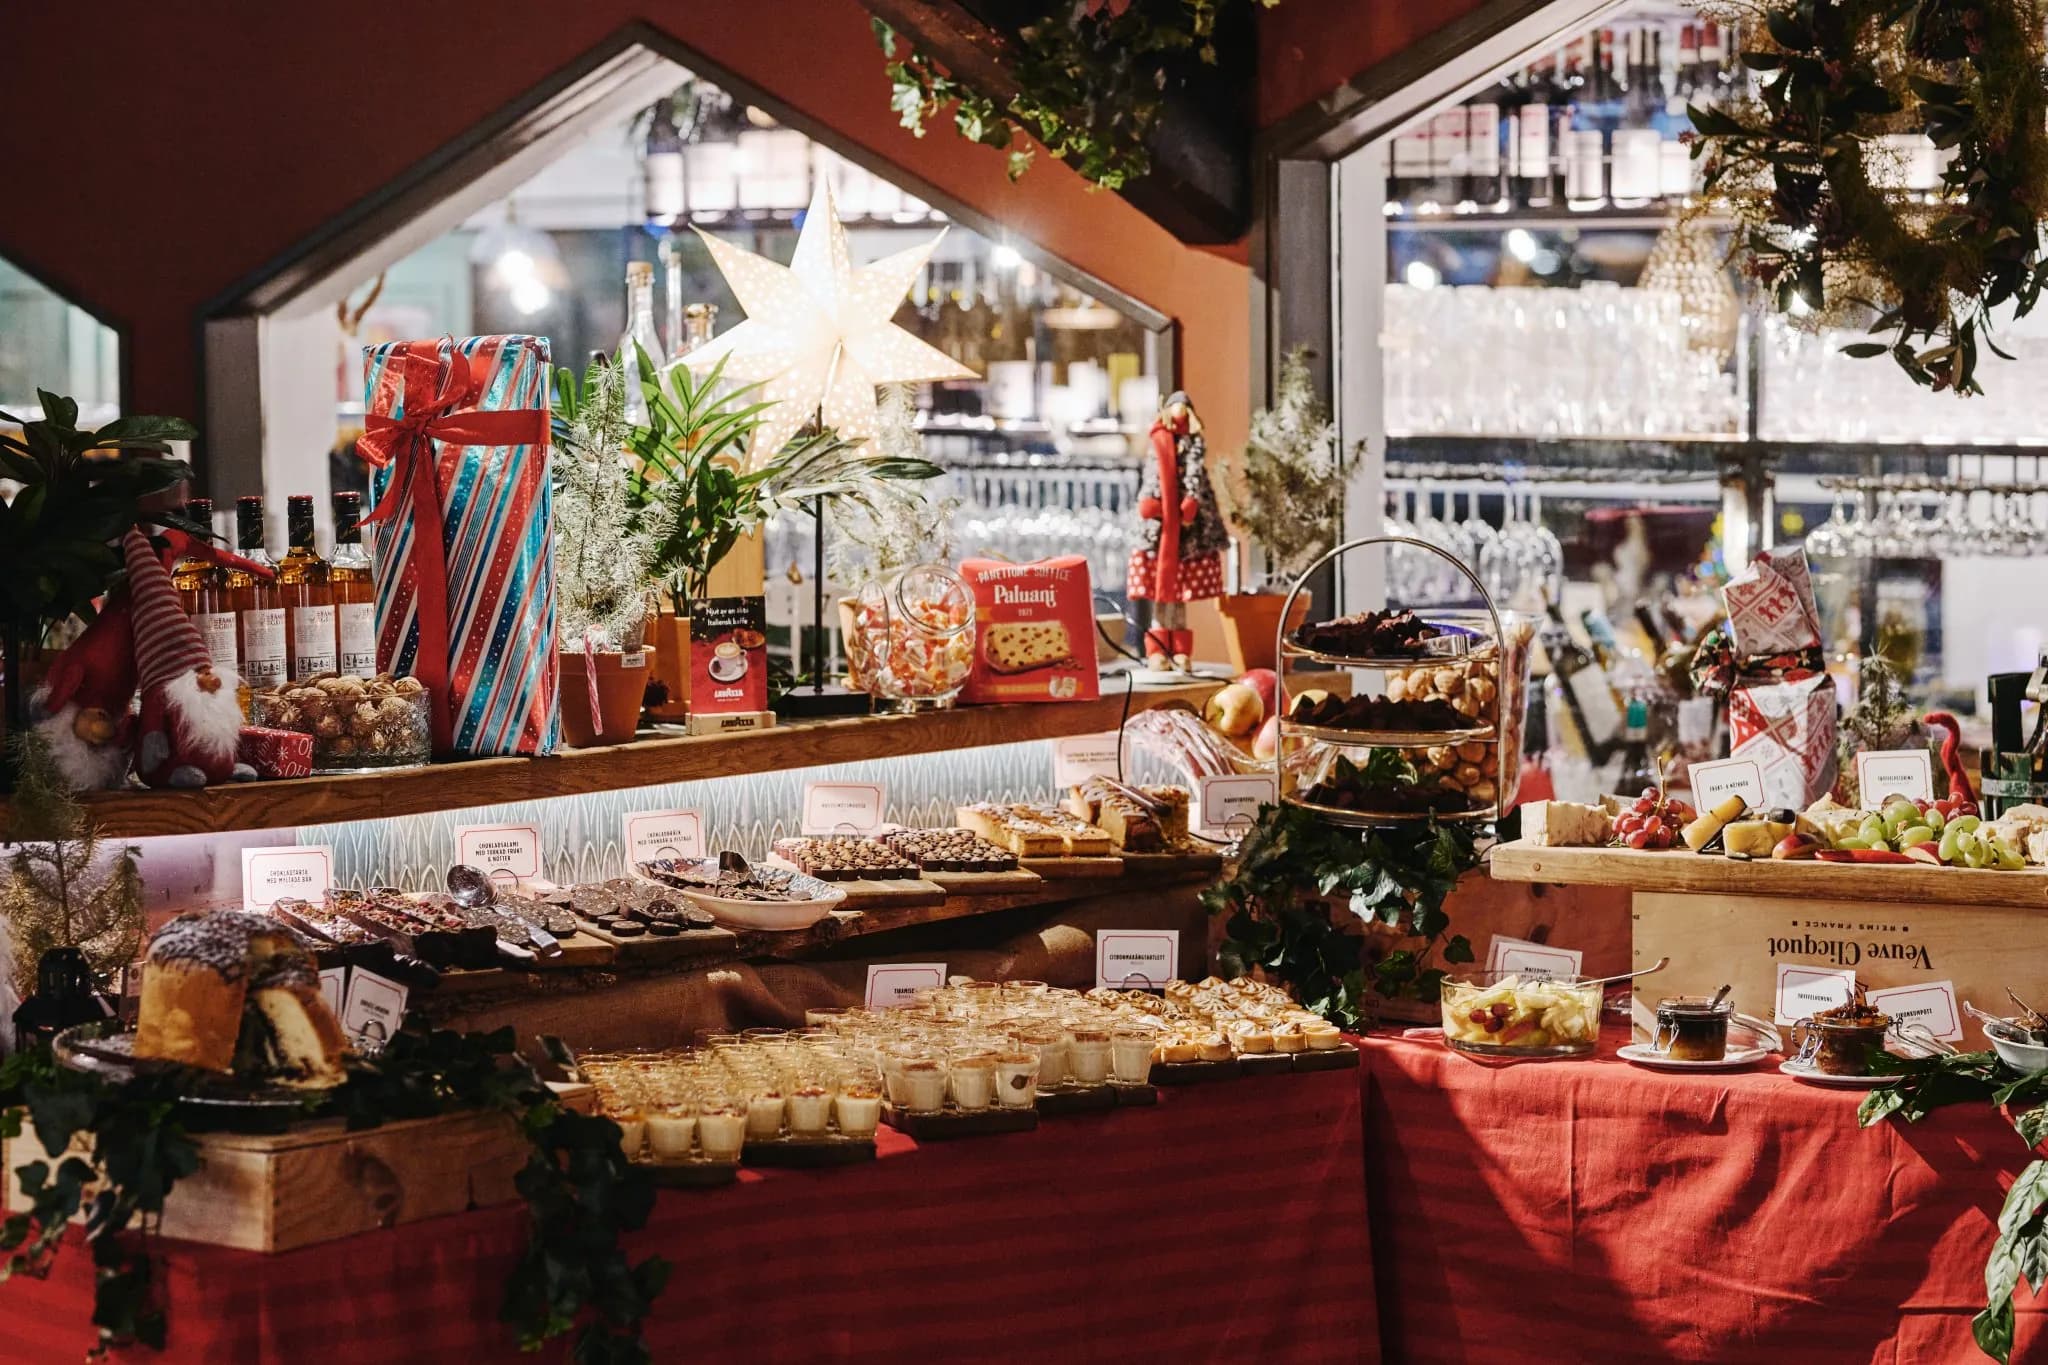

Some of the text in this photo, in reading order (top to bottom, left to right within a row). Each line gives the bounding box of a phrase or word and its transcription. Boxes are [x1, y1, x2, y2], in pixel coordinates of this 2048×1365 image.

[994, 584, 1057, 608] Paluani
[1805, 921, 1896, 932] REIMS FRANCE
[1768, 934, 1935, 970] Veuve Clicquot
